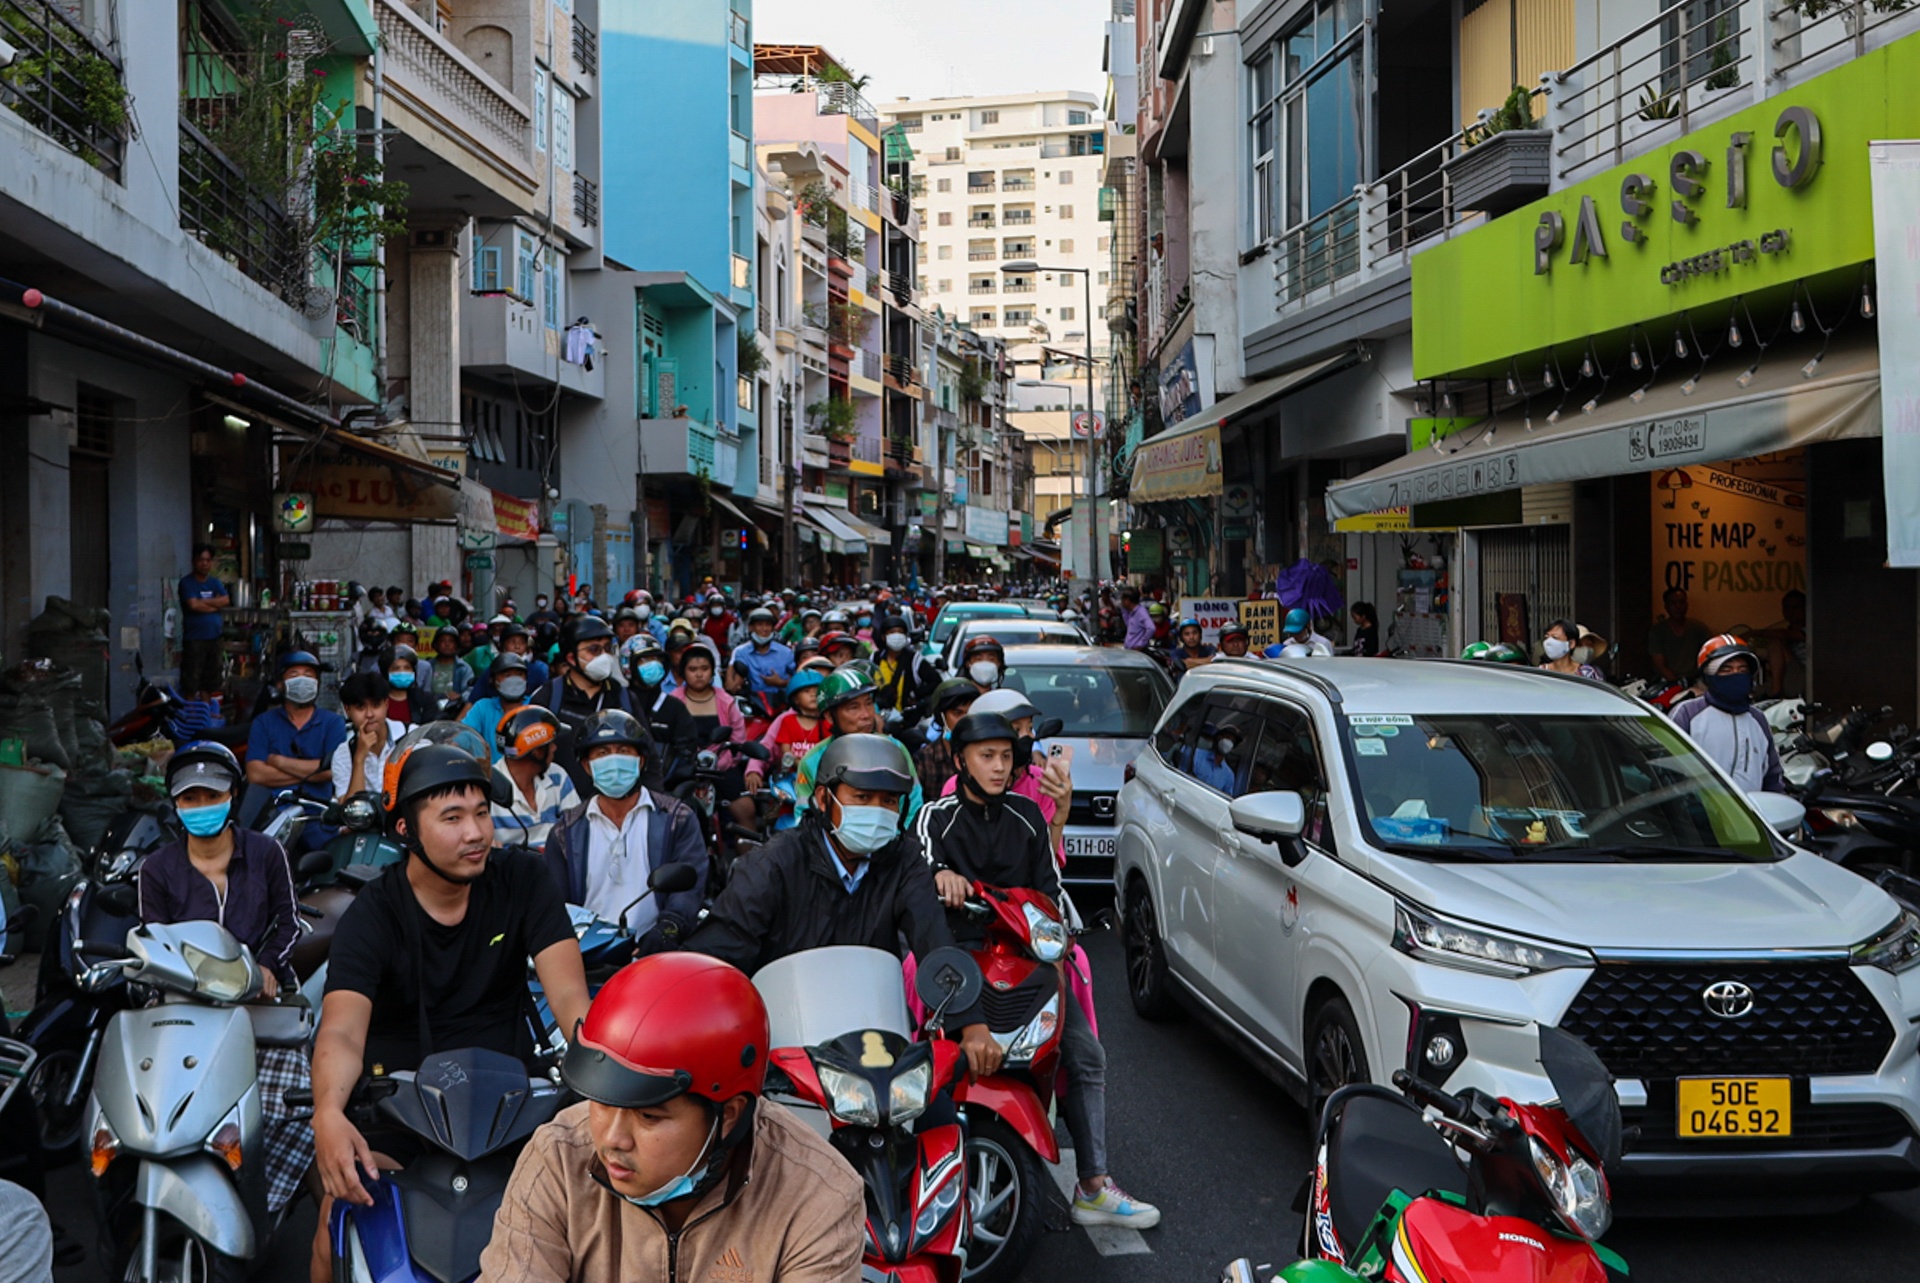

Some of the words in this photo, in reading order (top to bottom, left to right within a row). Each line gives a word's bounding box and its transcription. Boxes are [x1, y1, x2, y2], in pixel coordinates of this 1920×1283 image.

[1683, 419, 1700, 432] 8pm
[1709, 472, 1778, 501] PROFESSIONAL
[1664, 522, 1703, 549] THE
[1711, 522, 1756, 549] MAP
[1665, 560, 1695, 591] OF
[1702, 560, 1807, 592] PASSION
[1246, 604, 1275, 618] BÁNH
[1711, 1081, 1758, 1105] 50E
[1691, 1109, 1779, 1133] 046.92
[1498, 1231, 1546, 1251] HONDA
